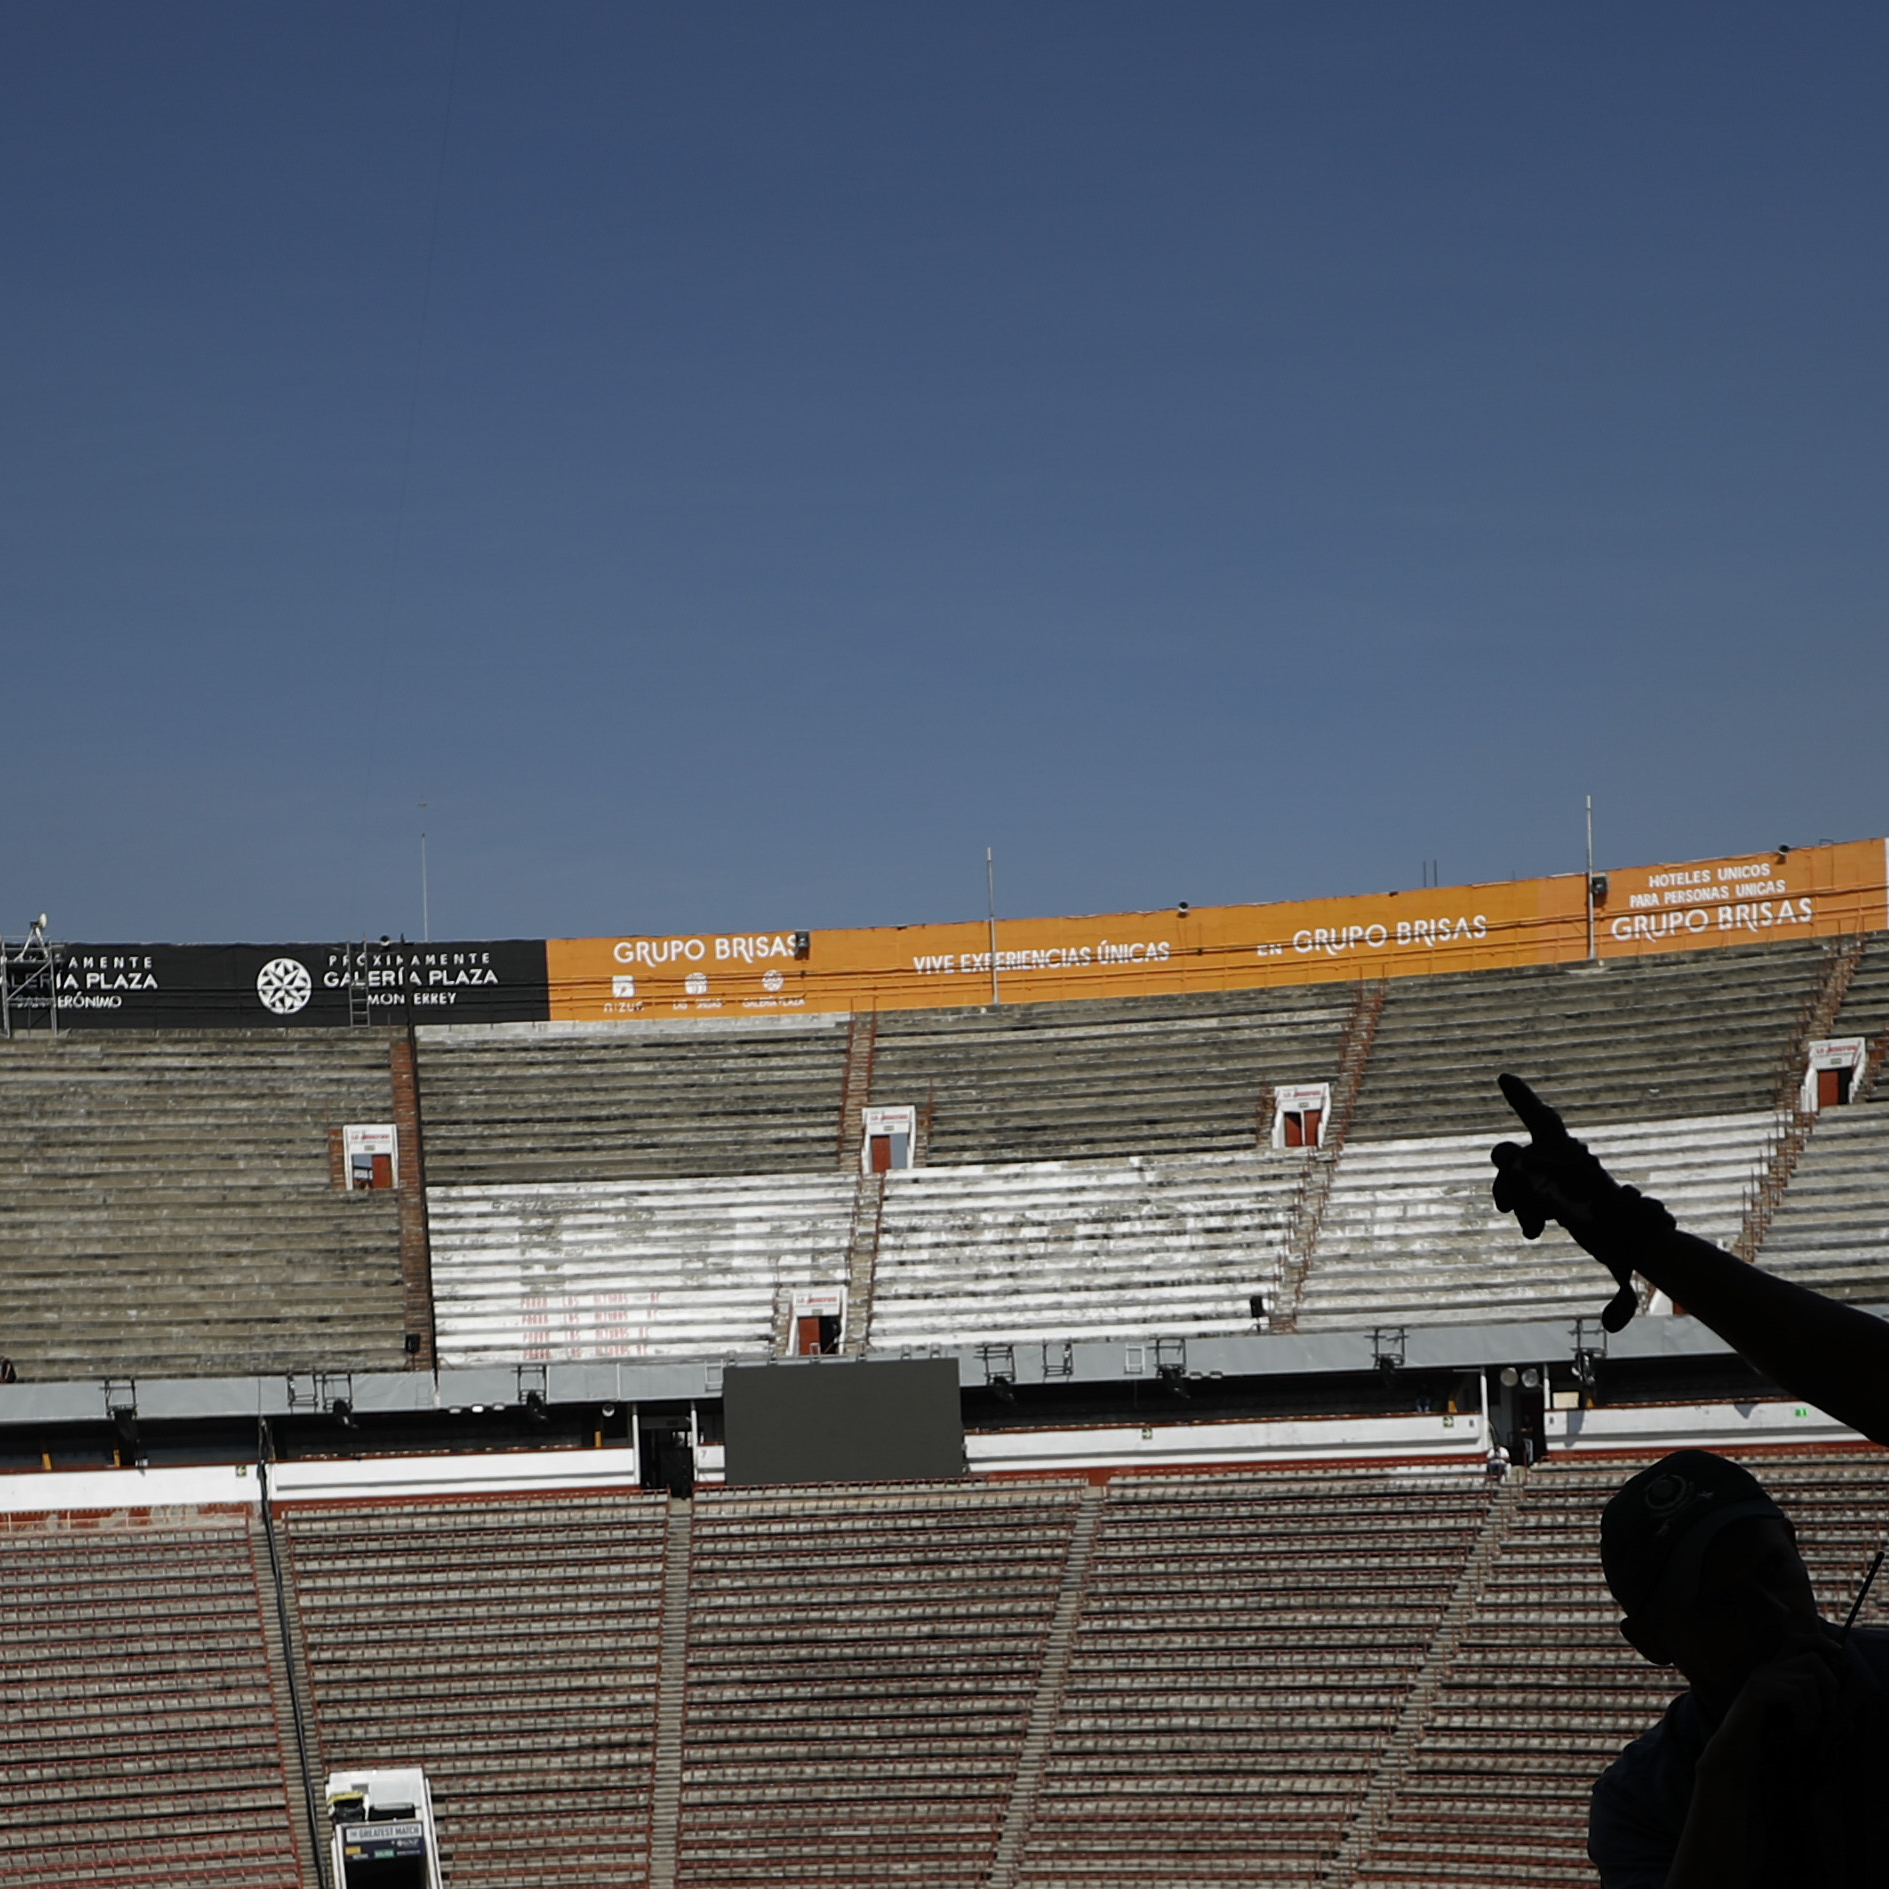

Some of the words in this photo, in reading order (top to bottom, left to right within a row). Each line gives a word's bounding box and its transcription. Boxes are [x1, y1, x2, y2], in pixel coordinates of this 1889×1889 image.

[1648, 870, 1711, 889] HOTELES
[1717, 863, 1771, 882] UNICOS
[1629, 893, 1660, 909] PARA
[1663, 886, 1729, 906] PERSONAS
[1735, 879, 1786, 898] UNICAS
[1611, 908, 1710, 943] GRUPO
[1717, 897, 1813, 933] BRISAS
[1291, 923, 1388, 956] GRUPO
[1395, 915, 1487, 948] BRISAS
[613, 938, 706, 968] GRUPO
[715, 934, 798, 964] BRISAS
[913, 954, 955, 975] VIVE
[960, 946, 1091, 973] EXPERIENCIAS
[1096, 939, 1171, 966] ÚNICAS
[85, 972, 159, 990] PLAZA
[322, 967, 422, 988] GALERÍA
[429, 968, 499, 987] PLAZA
[55, 992, 123, 1010] ERÓNIMO
[366, 991, 458, 1007] MONERREY
